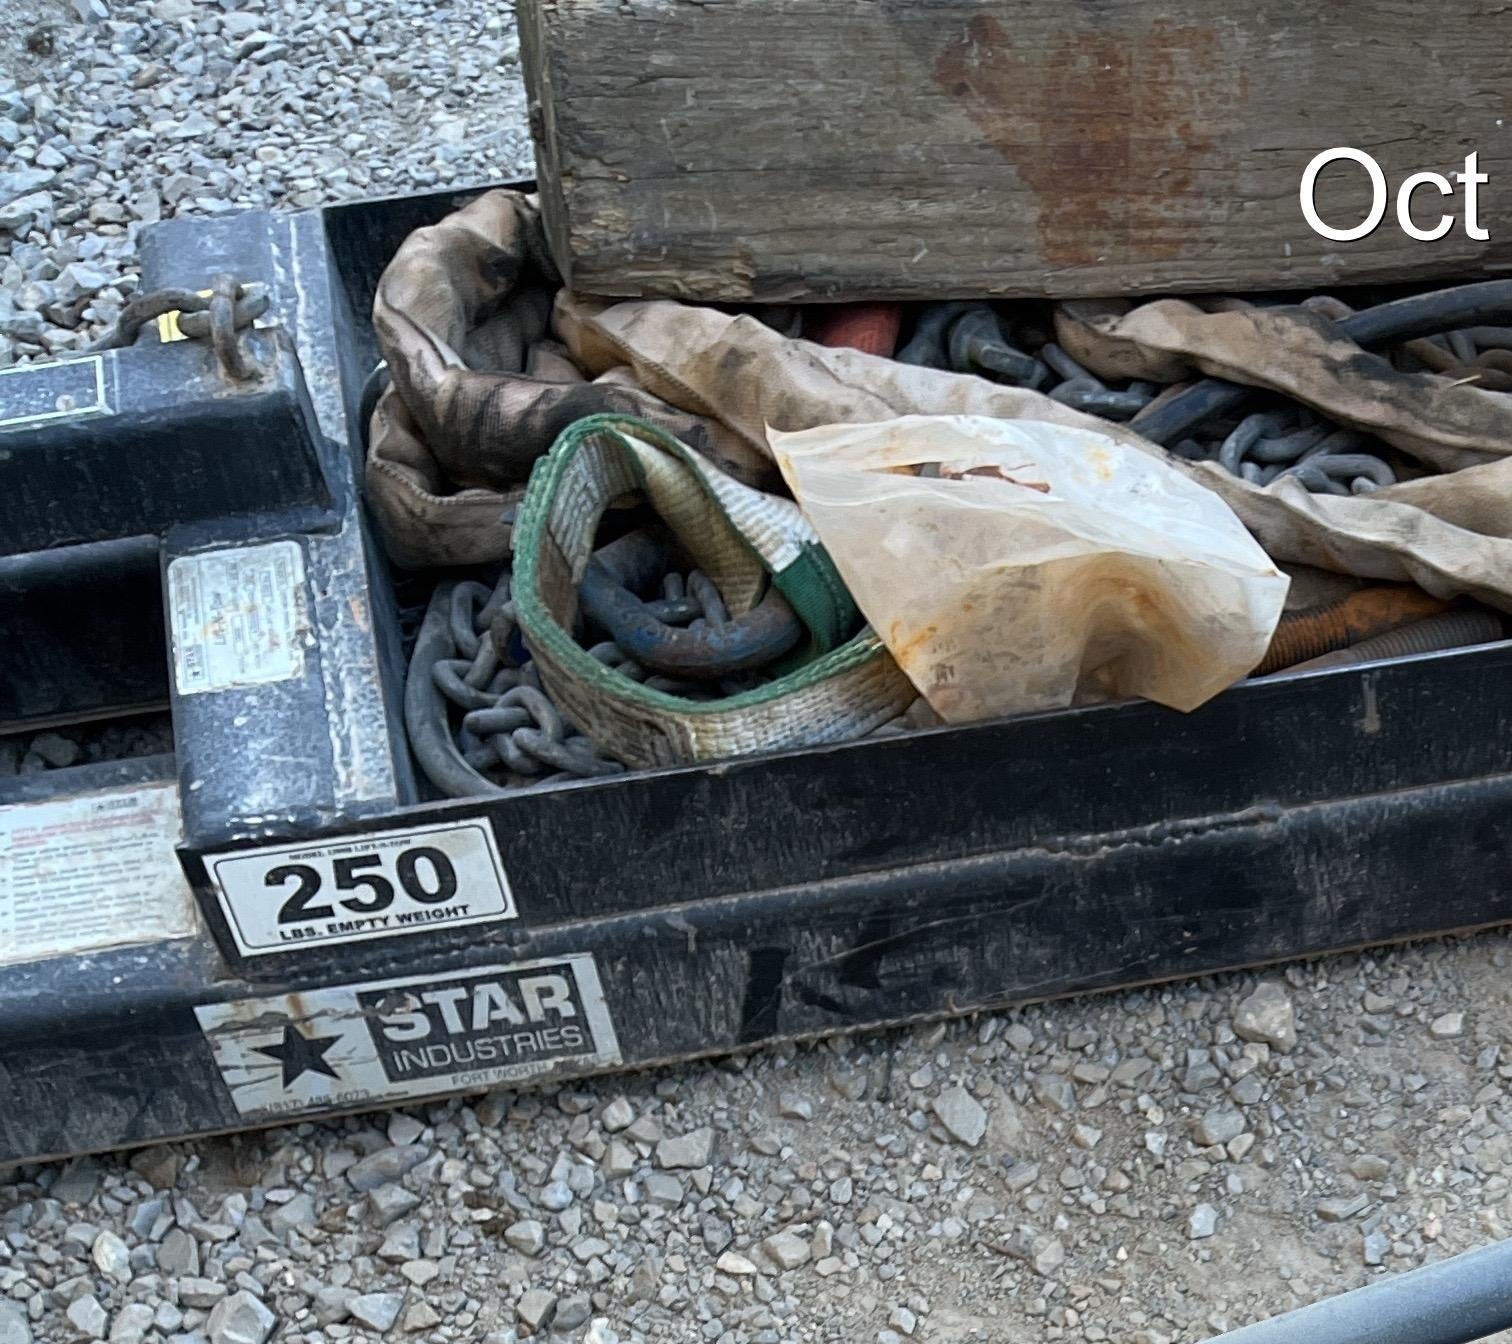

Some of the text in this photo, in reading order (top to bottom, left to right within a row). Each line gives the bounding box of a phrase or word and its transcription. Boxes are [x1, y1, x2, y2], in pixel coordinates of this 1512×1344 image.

[264, 846, 458, 925] 250
[279, 904, 471, 941] LBS. EMPTY WEIGHT
[375, 973, 577, 1042] STAR
[392, 1024, 584, 1074] INDUSTRIES
[451, 1071, 490, 1087] FORT
[494, 1062, 549, 1082] WORTH
